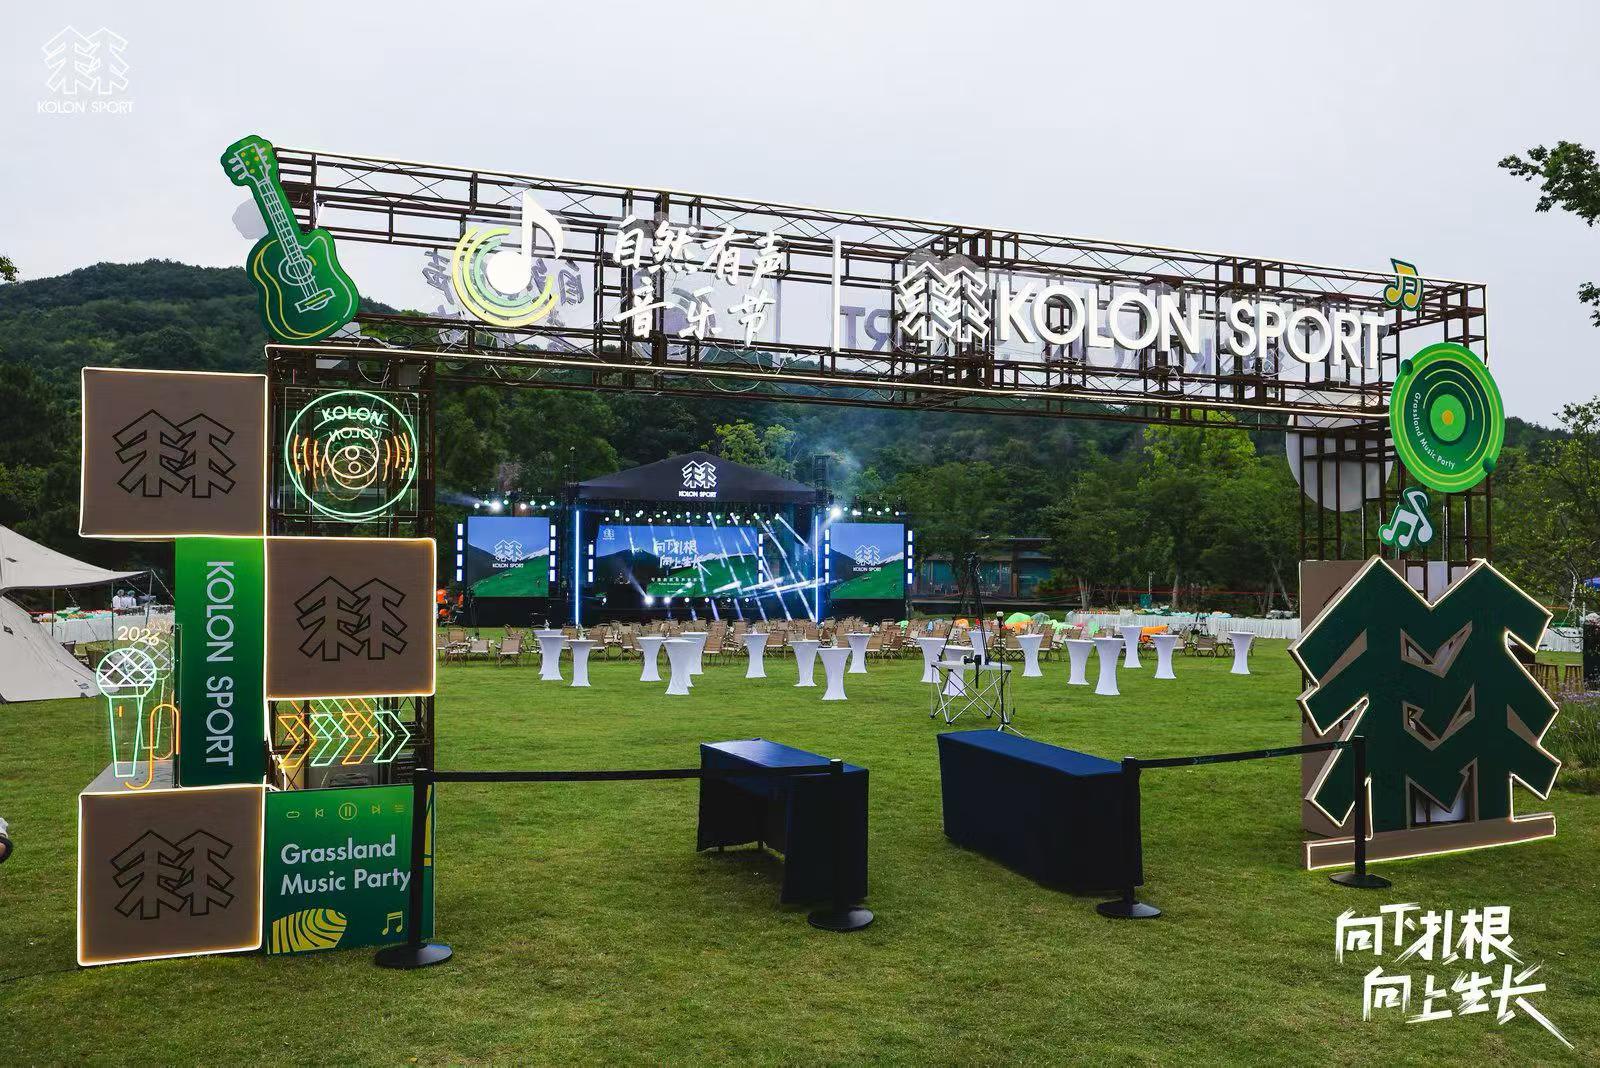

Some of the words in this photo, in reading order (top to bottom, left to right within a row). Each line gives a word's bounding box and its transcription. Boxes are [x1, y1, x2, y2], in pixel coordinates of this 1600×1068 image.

[613, 215, 785, 289] 自然有声
[613, 276, 775, 347] 音乐节
[1000, 280, 1201, 354] KOLON
[1226, 300, 1388, 369] SPORT
[321, 405, 384, 426] KOLON
[1413, 392, 1424, 437] Grassland
[1420, 438, 1437, 459] Music
[1437, 455, 1455, 470] Party
[117, 625, 161, 646] 2026
[205, 561, 235, 662] KOLON
[205, 675, 234, 767] SPORT
[280, 834, 396, 865] Grassland
[280, 870, 346, 896] Music
[354, 867, 411, 892] Party
